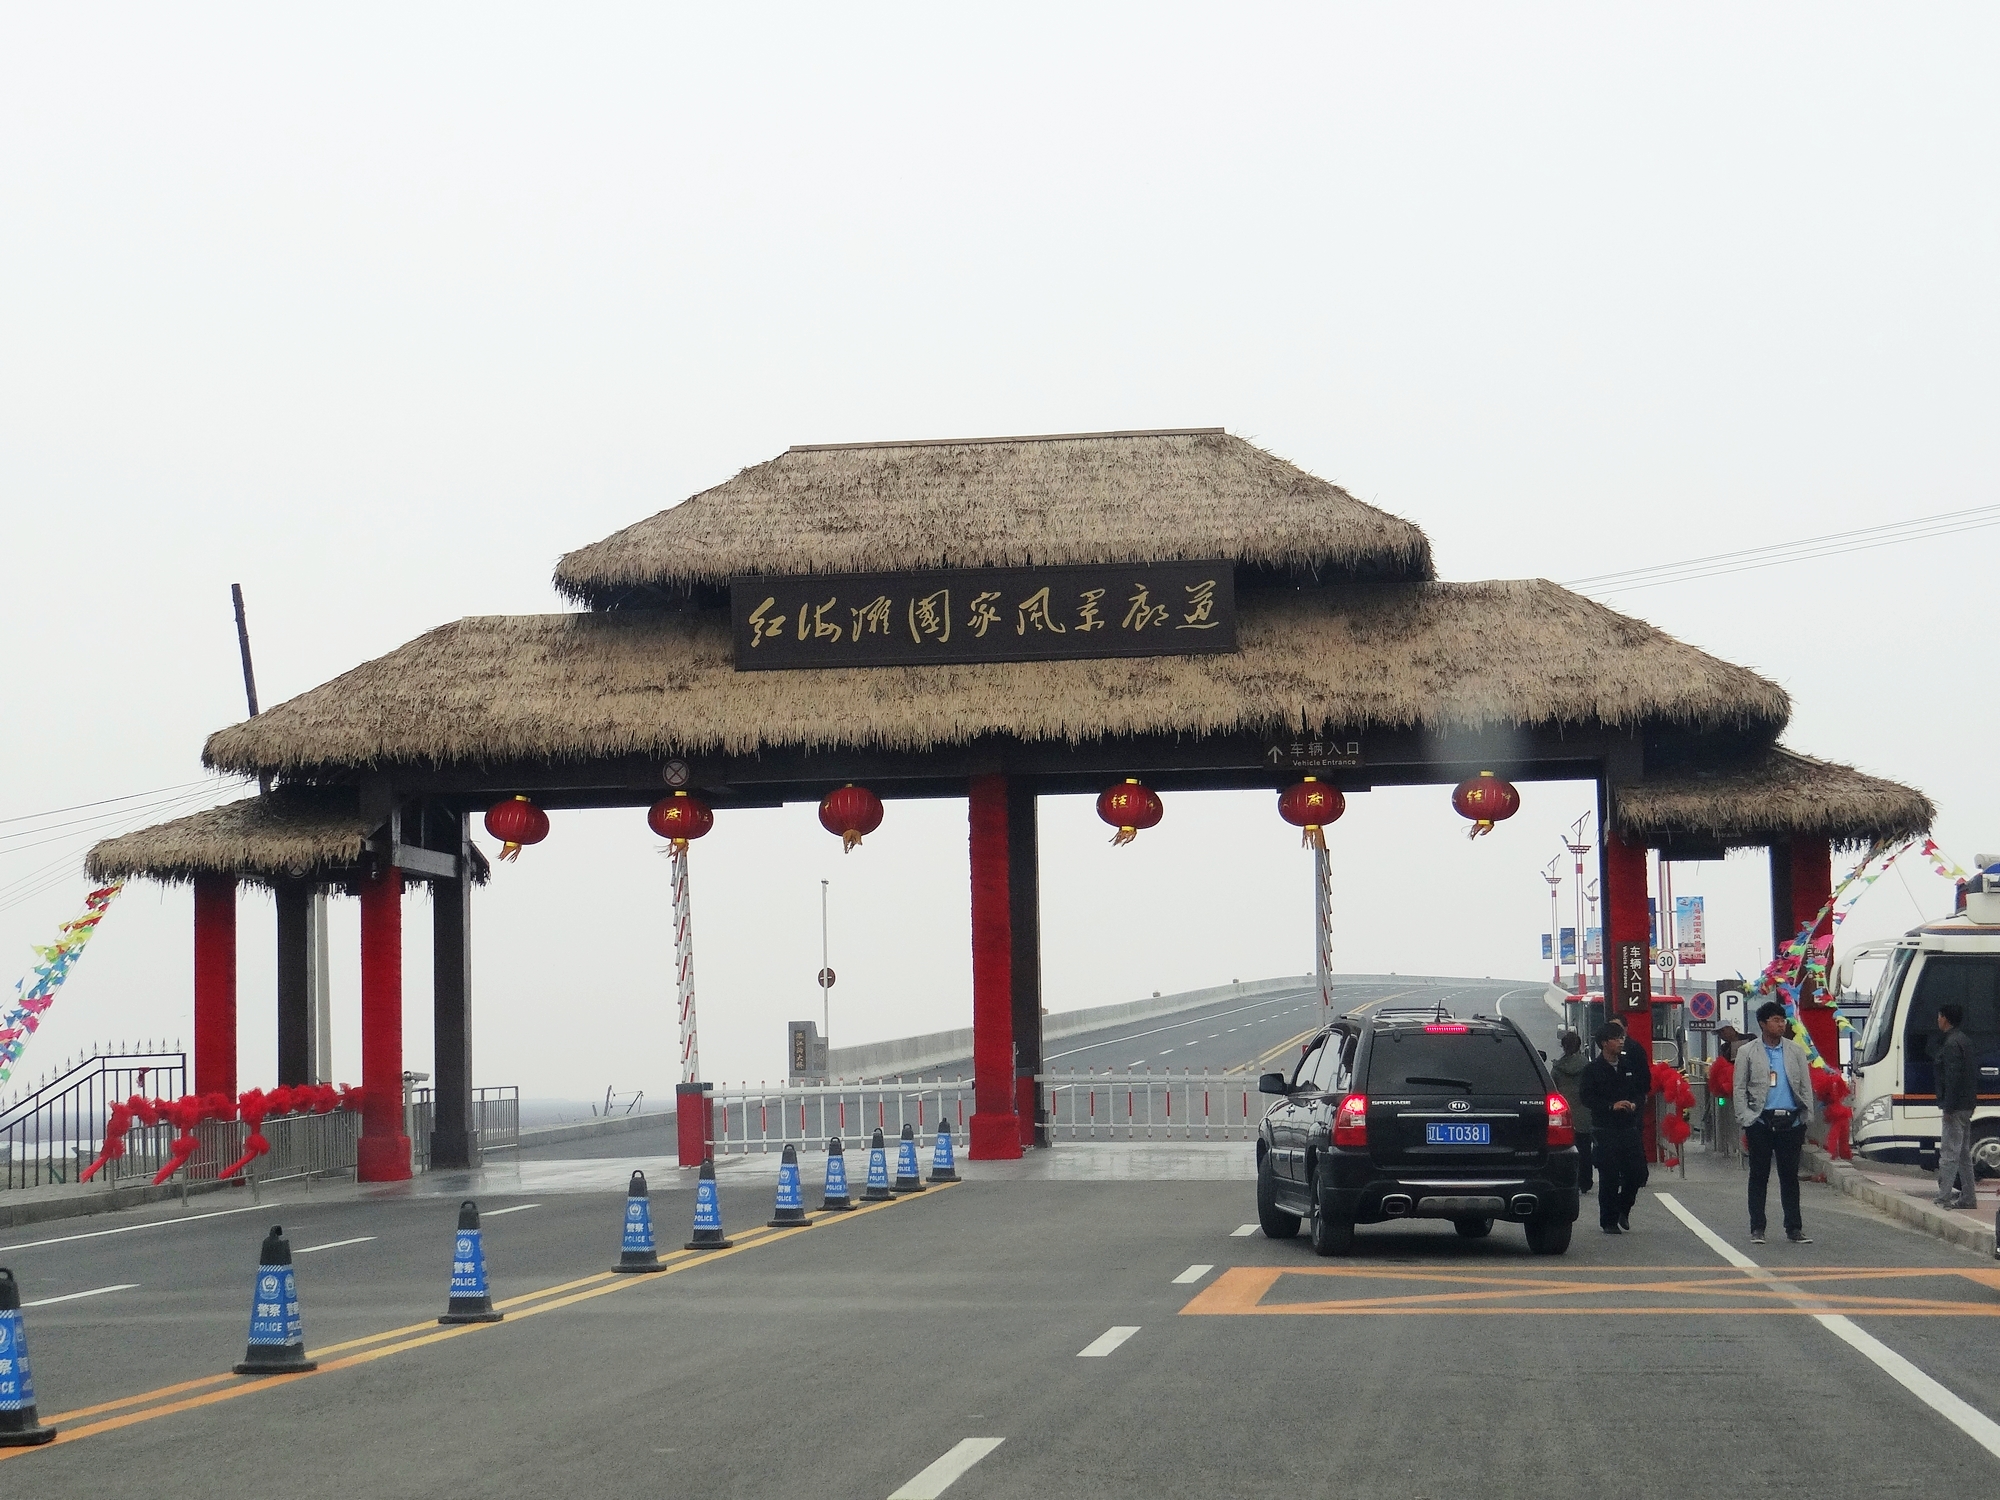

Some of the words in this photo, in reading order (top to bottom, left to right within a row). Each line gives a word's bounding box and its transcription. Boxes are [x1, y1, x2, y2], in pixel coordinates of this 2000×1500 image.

[1290, 742, 1359, 757] 车辆入口
[1660, 956, 1673, 967] 30
[1630, 945, 1642, 993] 车辆入口
[1727, 995, 1738, 1010] P
[696, 1203, 713, 1213] 警察
[626, 1222, 644, 1233] 警察
[624, 1235, 645, 1243] POLICE
[454, 1261, 475, 1274] 警察
[451, 1277, 477, 1286] POLICE
[257, 1303, 281, 1317] 警察
[254, 1322, 283, 1332] POLICE
[0, 1359, 13, 1376] 察
